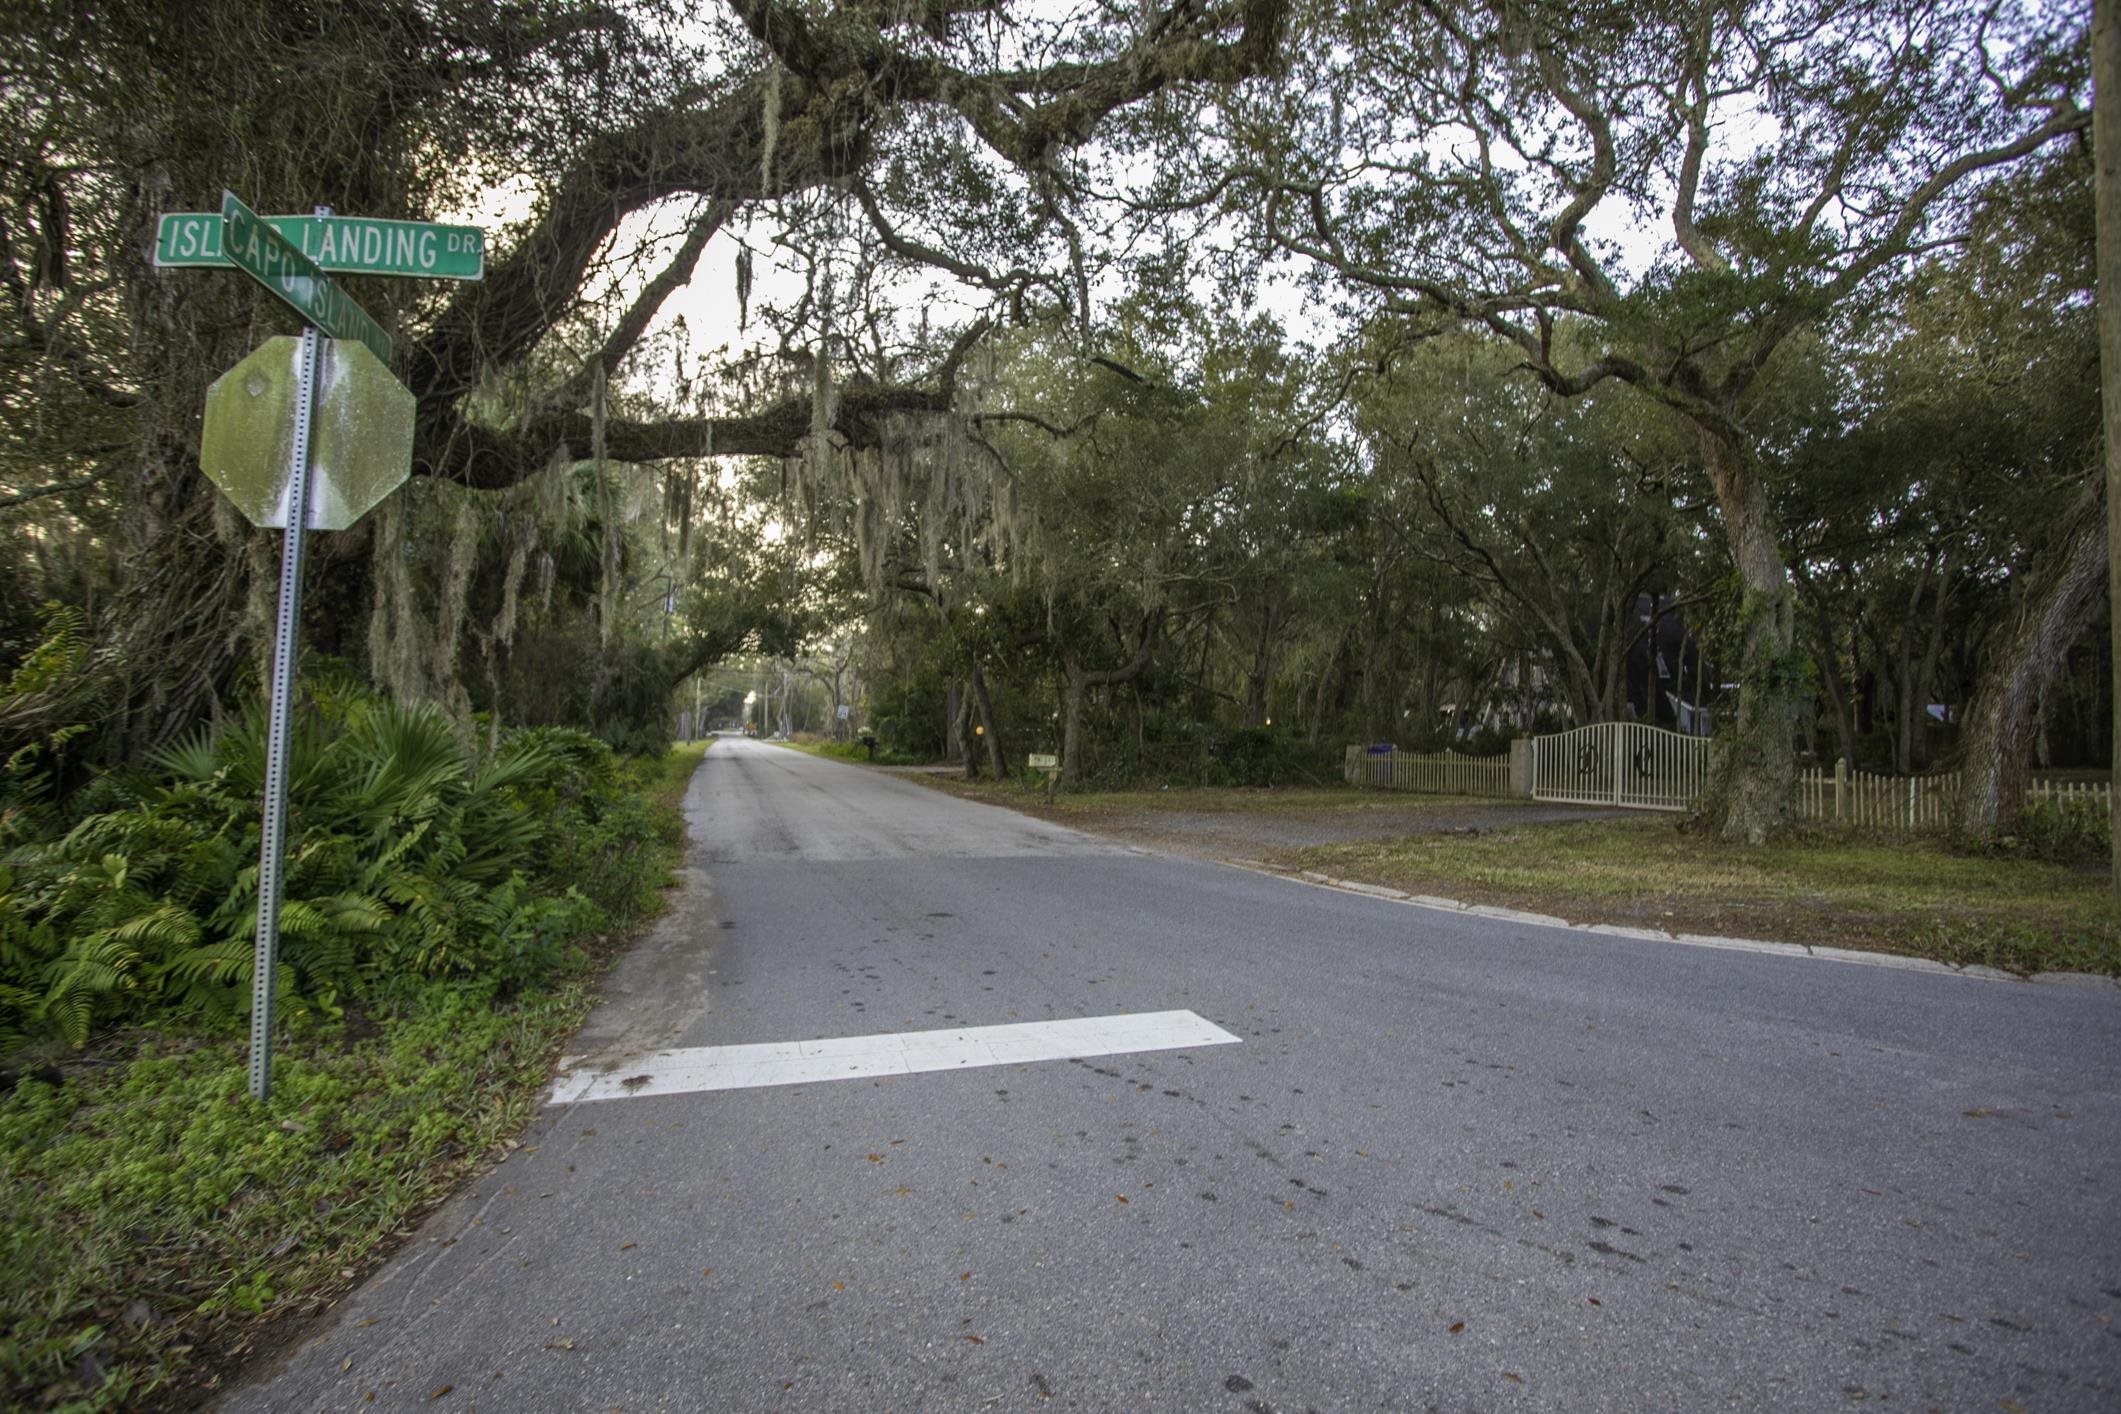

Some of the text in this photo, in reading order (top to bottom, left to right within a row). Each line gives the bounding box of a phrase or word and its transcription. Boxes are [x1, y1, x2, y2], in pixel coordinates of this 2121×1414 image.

[230, 210, 369, 345] CAPO ISLAND
[302, 223, 437, 268] LANDING
[447, 233, 476, 254] DR
